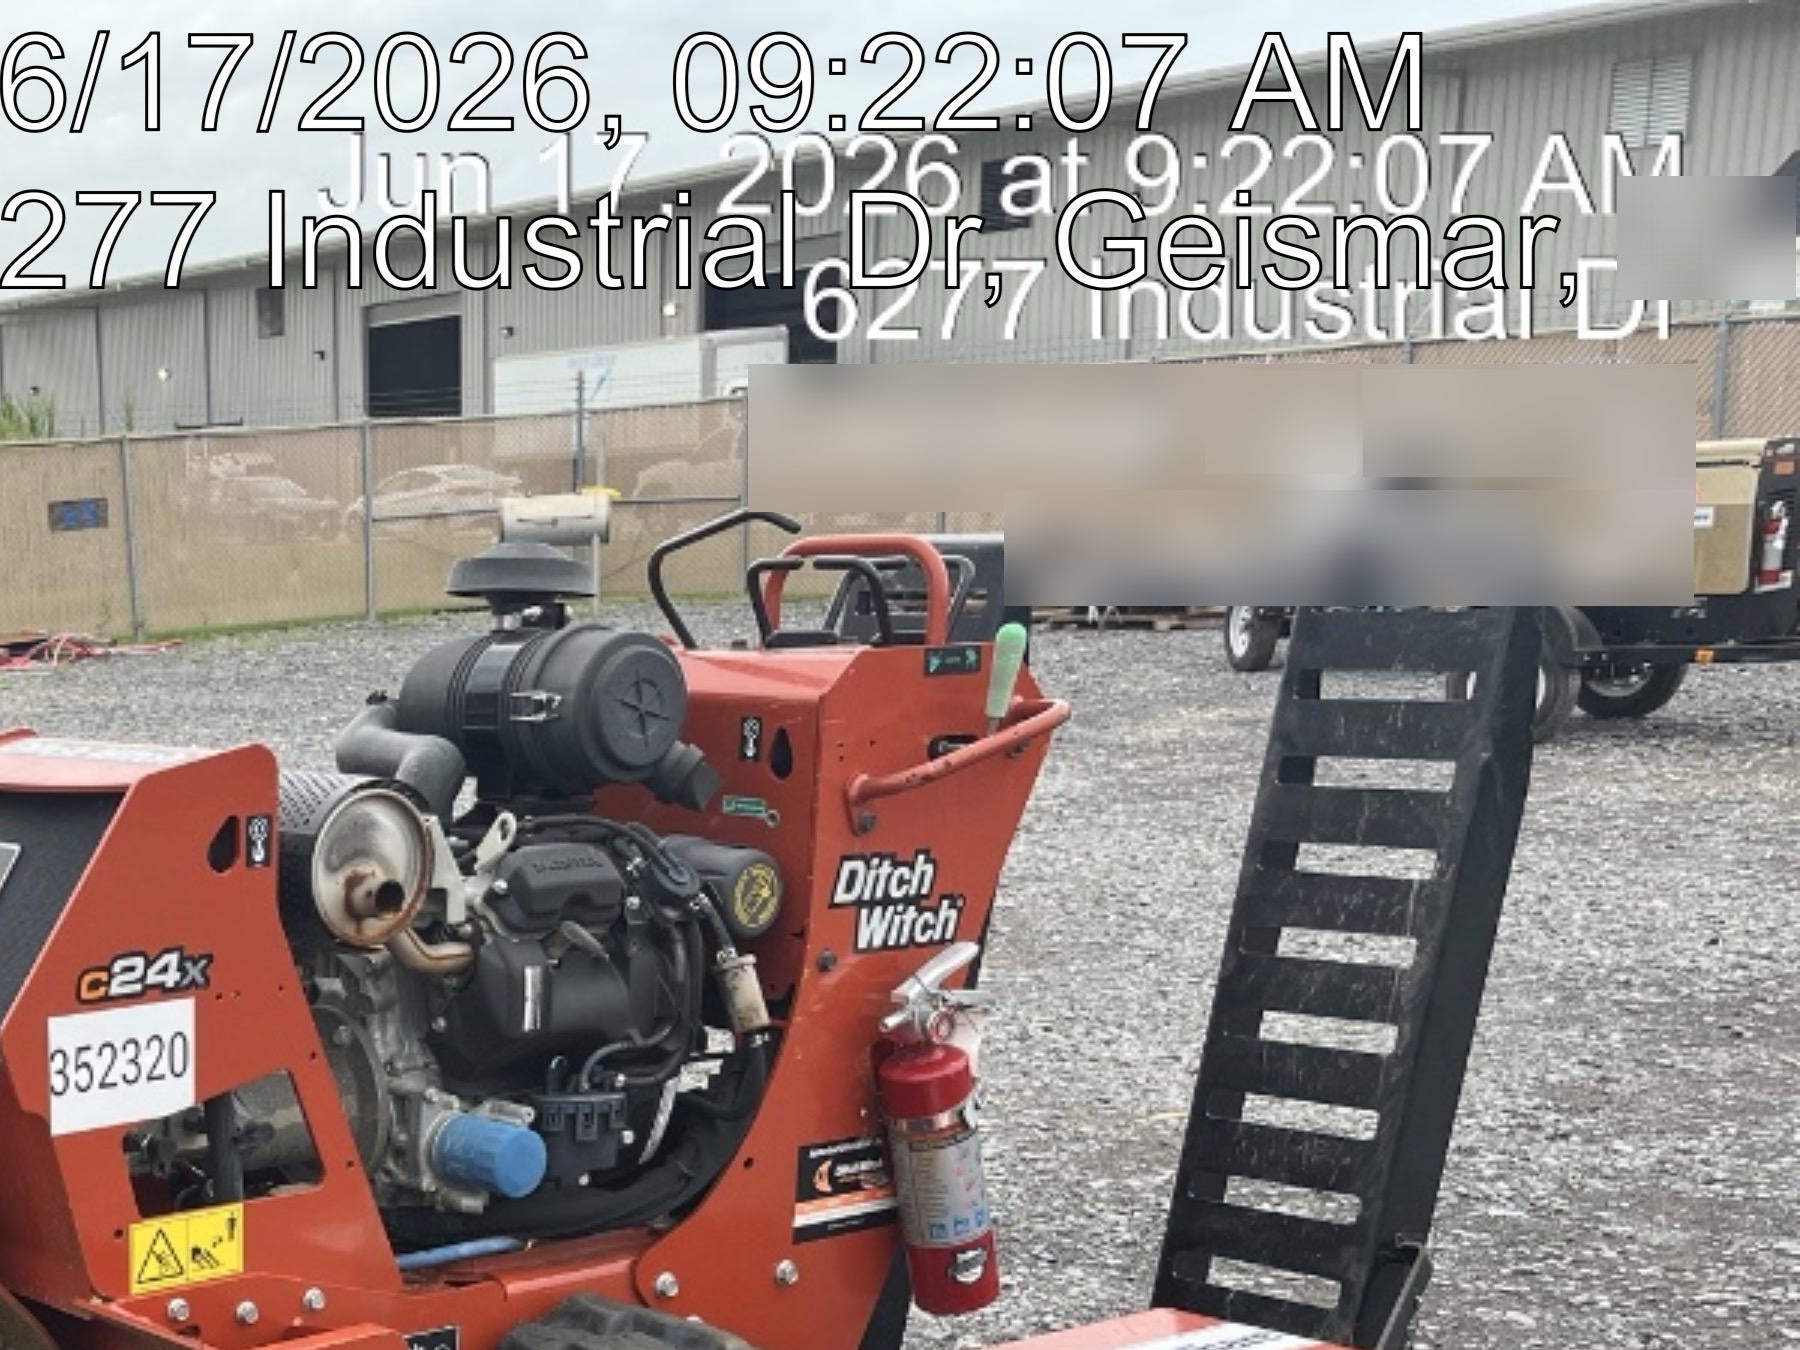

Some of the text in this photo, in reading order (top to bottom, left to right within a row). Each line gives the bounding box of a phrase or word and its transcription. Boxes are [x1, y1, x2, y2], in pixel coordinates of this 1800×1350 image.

[832, 852, 935, 905] Ditch
[856, 899, 959, 950] Witch
[49, 1030, 189, 1097] 352320
